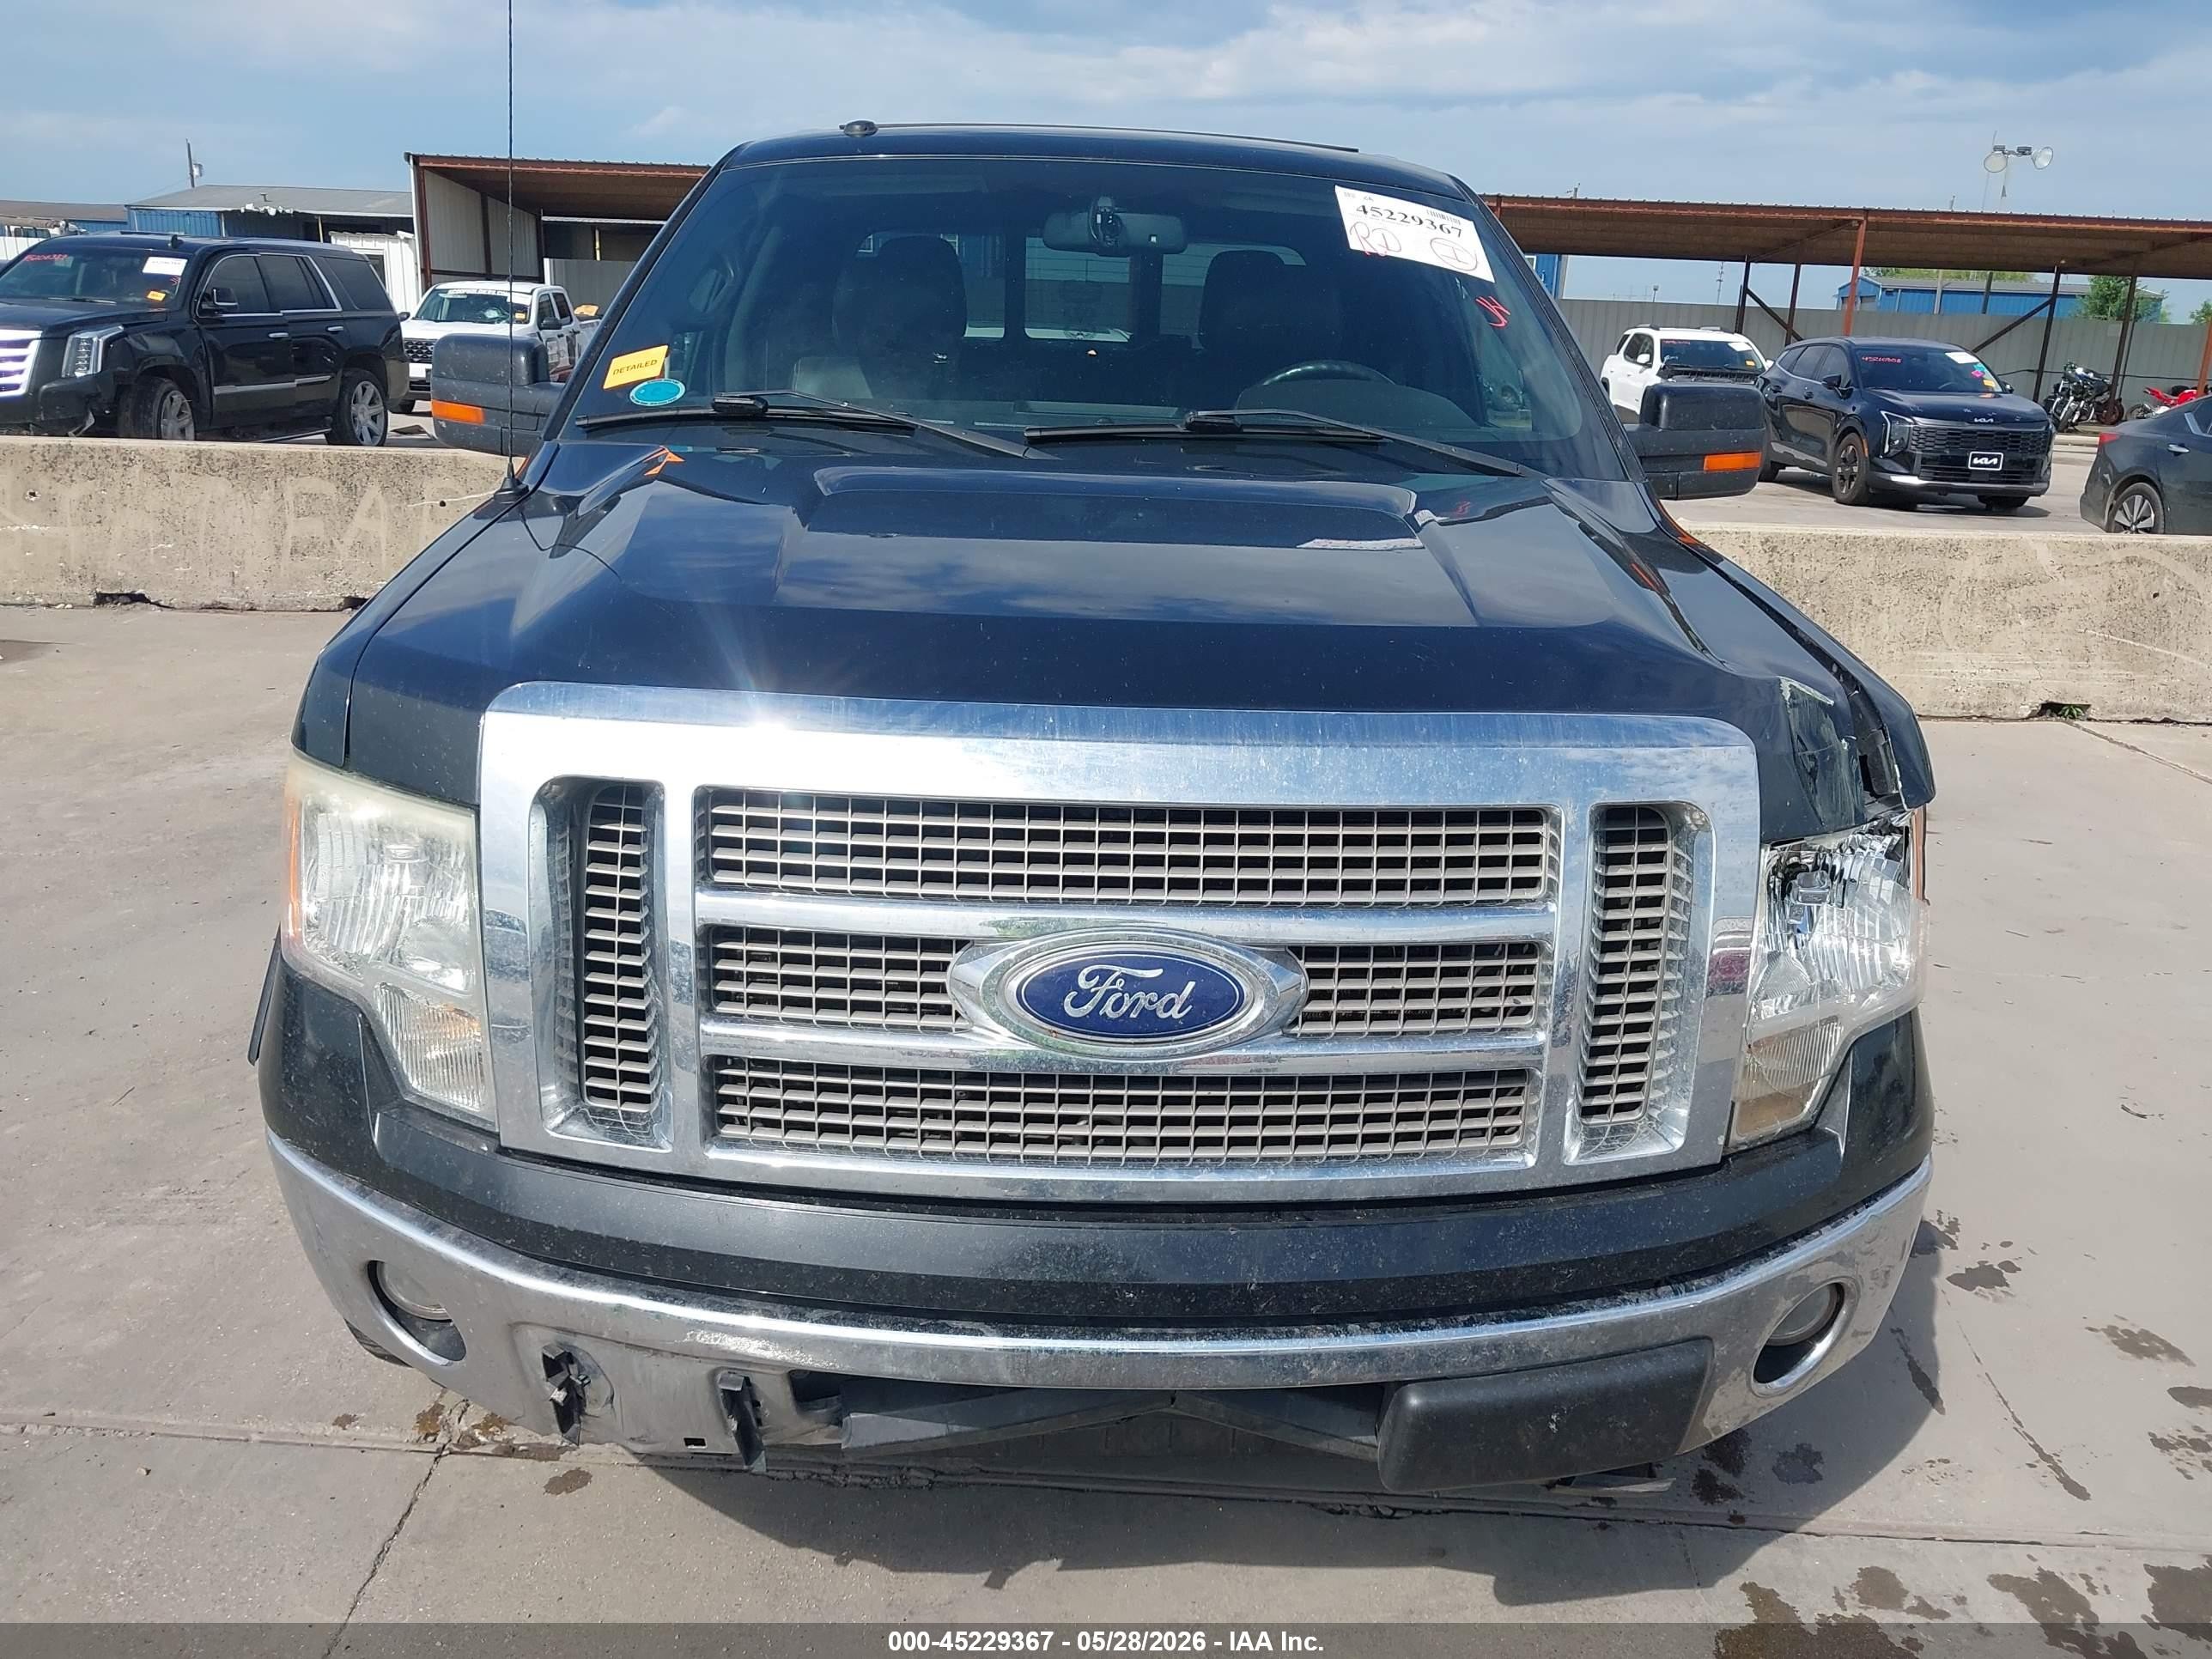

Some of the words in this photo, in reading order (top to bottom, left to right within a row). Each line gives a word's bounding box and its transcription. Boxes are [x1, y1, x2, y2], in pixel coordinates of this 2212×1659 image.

[1355, 204, 1462, 238] 45229367
[612, 359, 659, 376] DETAILED
[1972, 457, 1998, 465] KIA
[1063, 963, 1196, 1020] Ford
